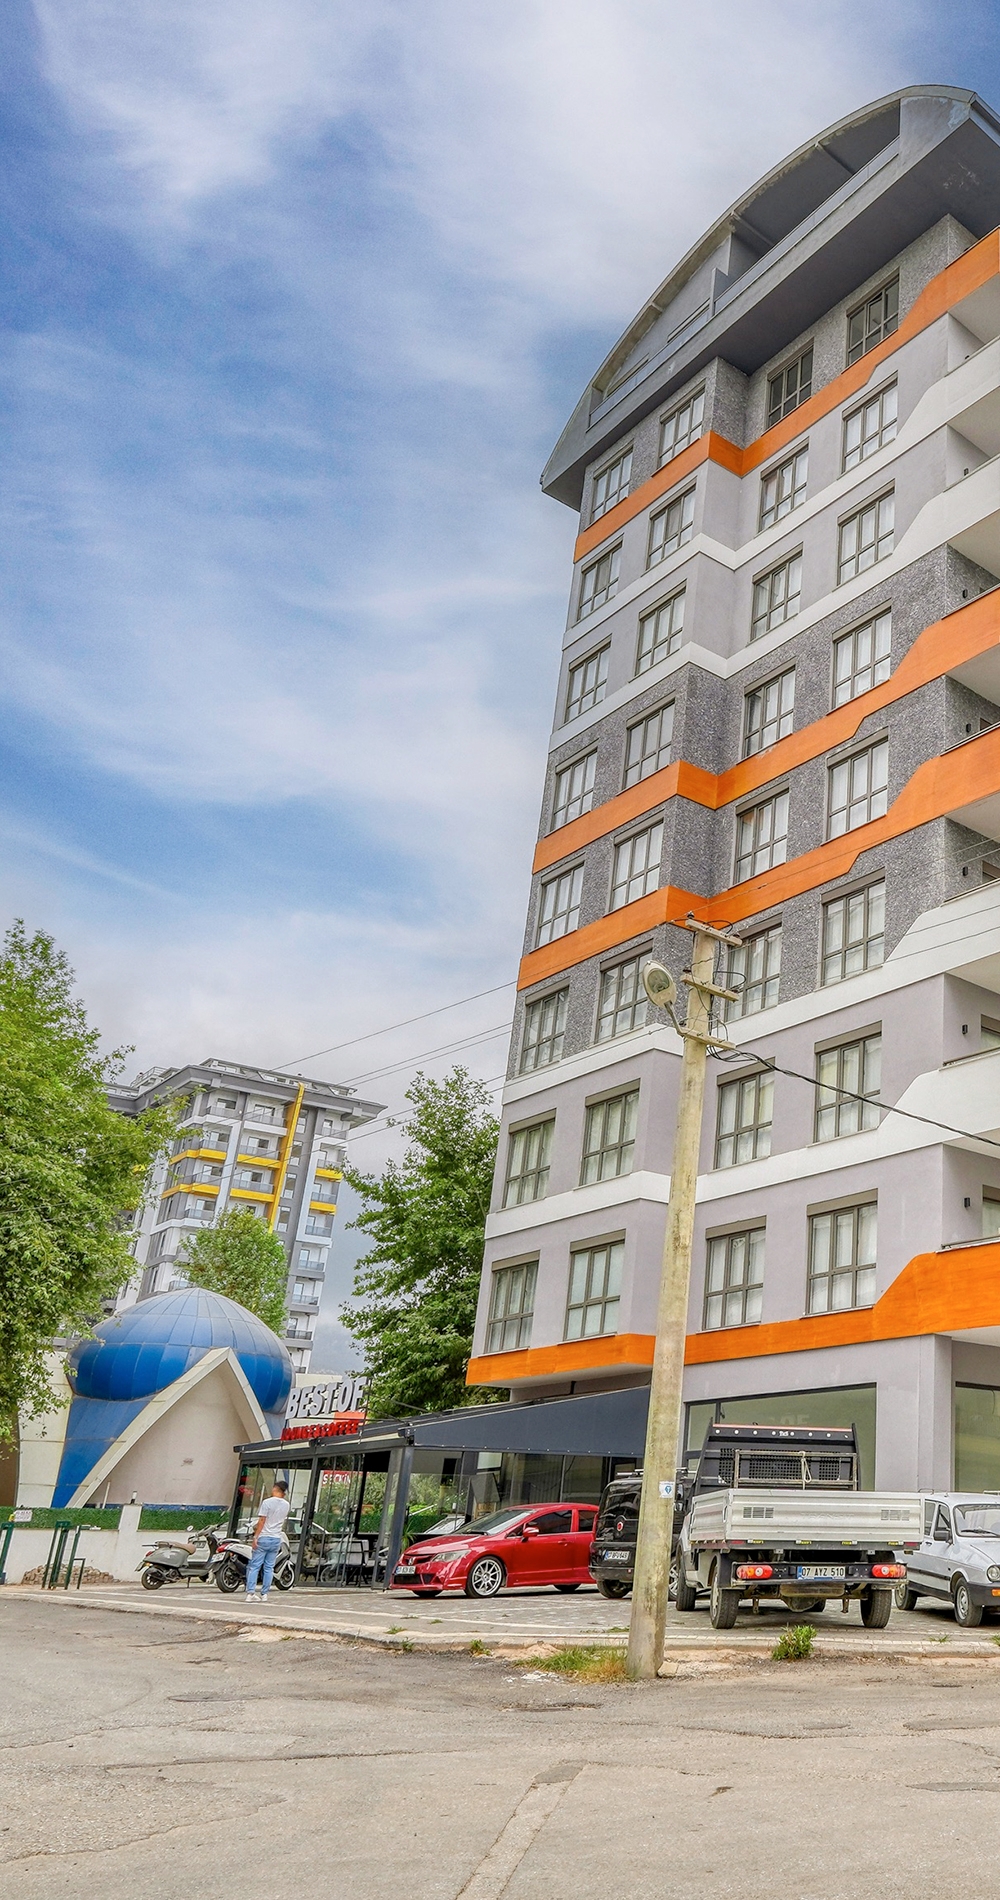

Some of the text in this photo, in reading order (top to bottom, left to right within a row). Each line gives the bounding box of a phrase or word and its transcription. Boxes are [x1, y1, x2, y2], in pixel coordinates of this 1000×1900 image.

[285, 1382, 338, 1420] BEST
[802, 1568, 844, 1576] 07 AYZ 510
